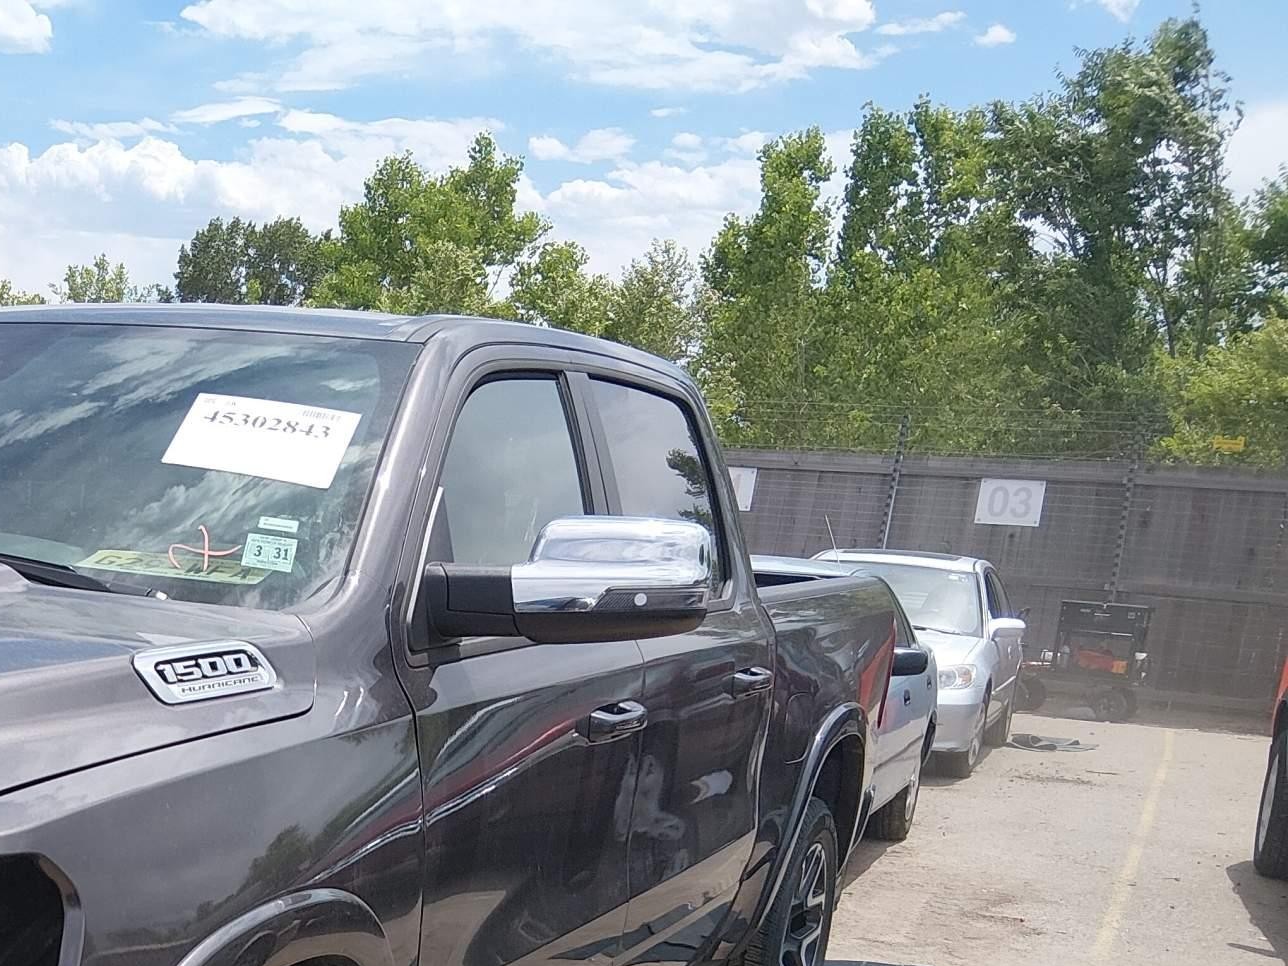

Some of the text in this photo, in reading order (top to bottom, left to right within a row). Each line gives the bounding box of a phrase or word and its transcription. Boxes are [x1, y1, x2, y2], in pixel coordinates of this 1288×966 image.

[203, 410, 332, 438] 45302843
[987, 485, 1034, 519] 03
[253, 544, 290, 561] 3 31
[156, 652, 259, 684] 1500
